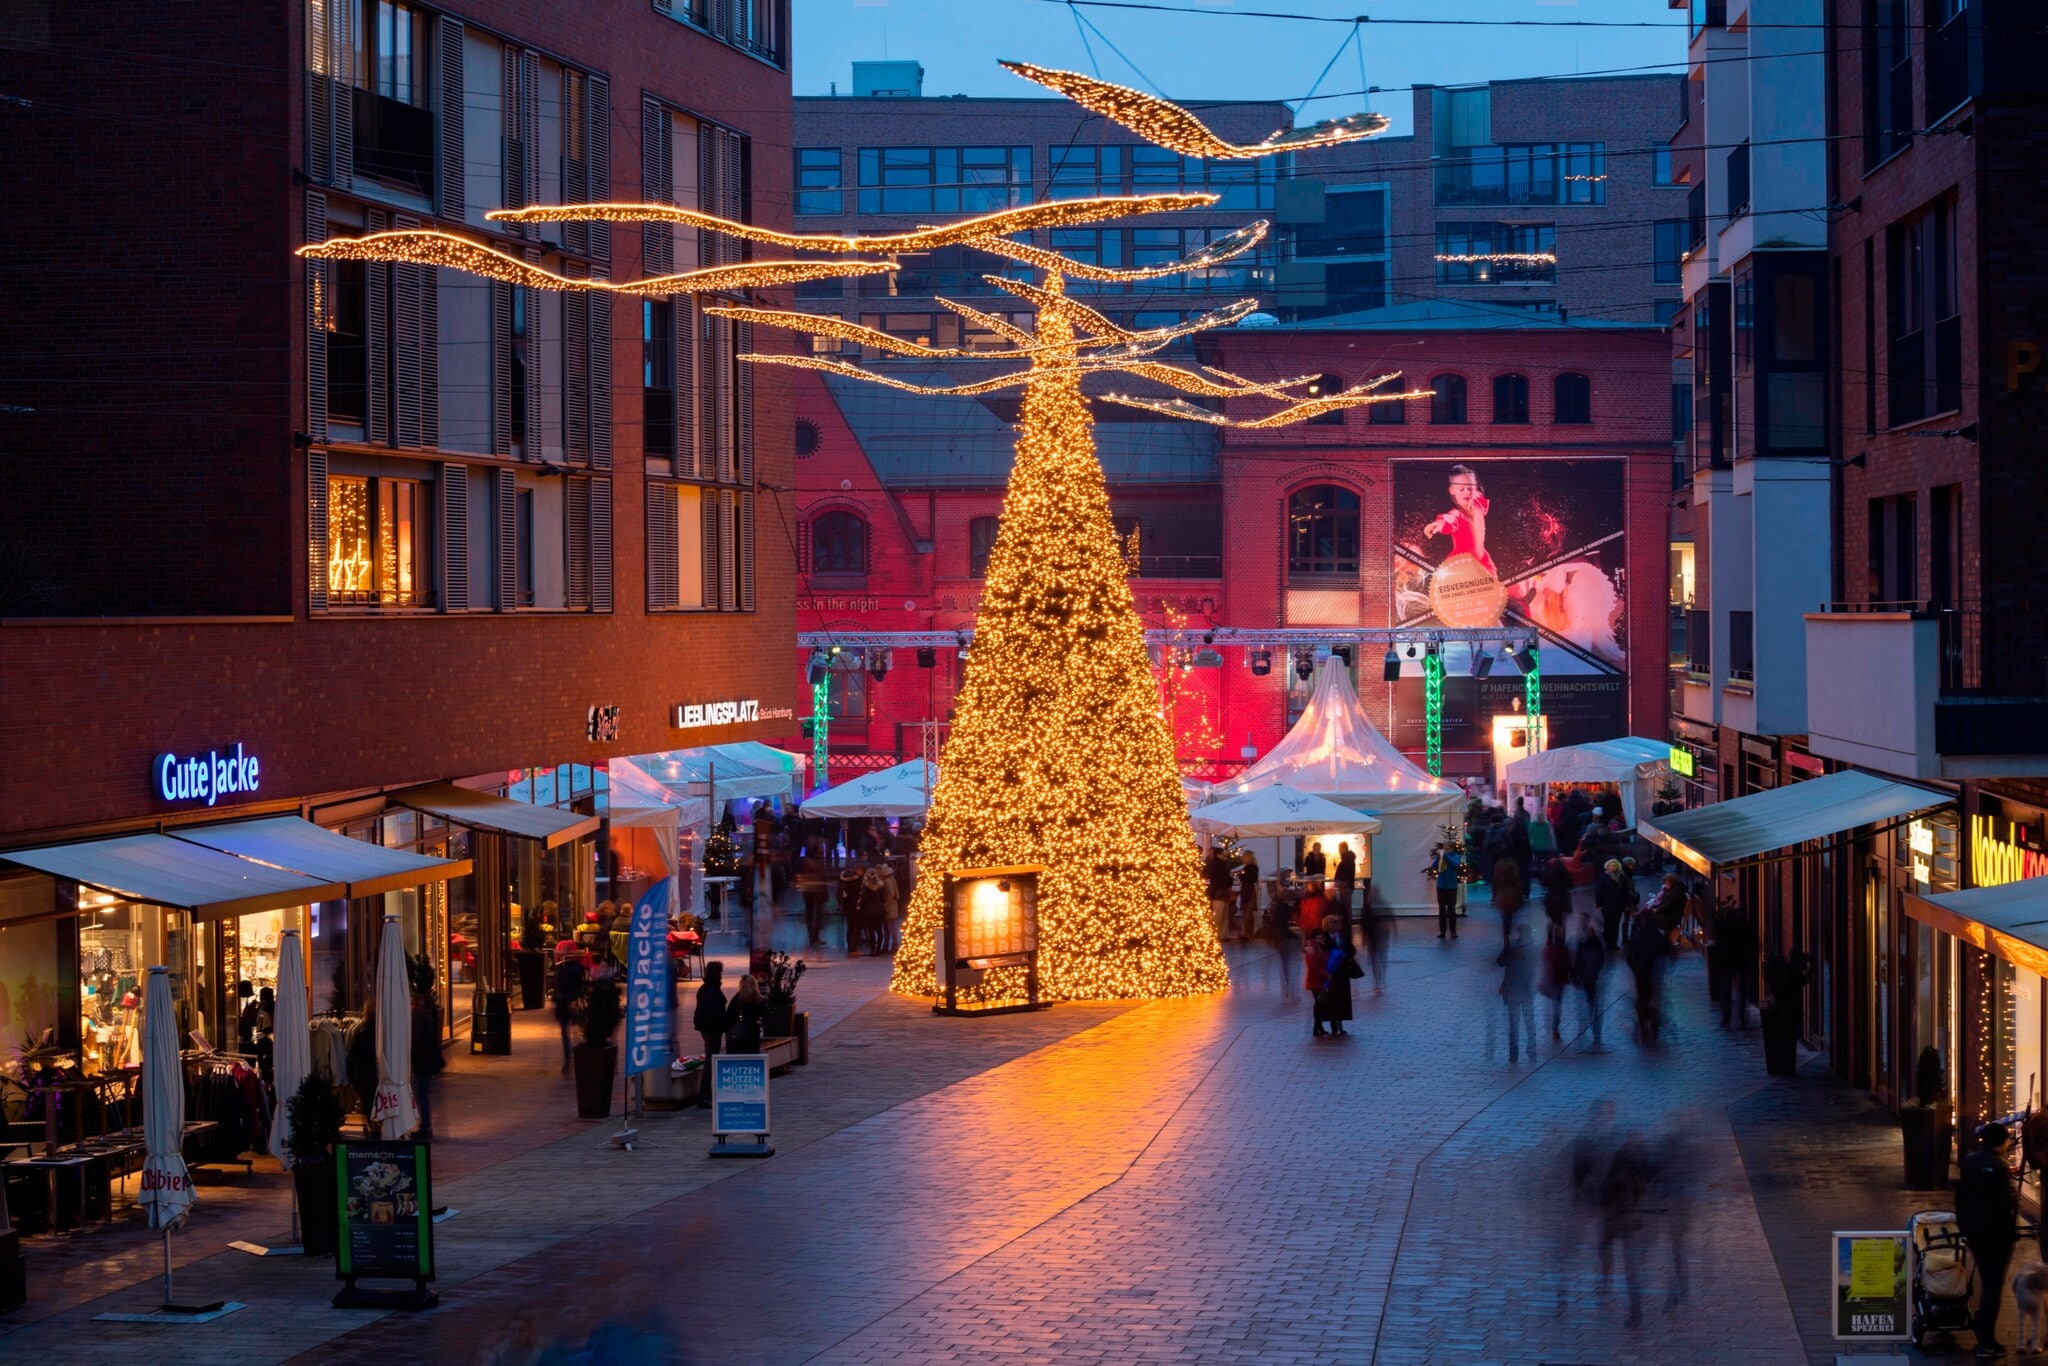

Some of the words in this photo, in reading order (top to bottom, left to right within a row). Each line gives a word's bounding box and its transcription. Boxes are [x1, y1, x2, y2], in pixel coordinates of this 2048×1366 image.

[1439, 577, 1495, 593] EISVERGNÜGEN
[813, 599, 824, 610] in
[827, 598, 846, 610] the
[849, 598, 879, 613] night
[1541, 682, 1620, 692] WEIHNACHTSWELT
[678, 700, 759, 729] LIEBLINGSPLATZ
[1851, 1314, 1895, 1325] HAFEN
